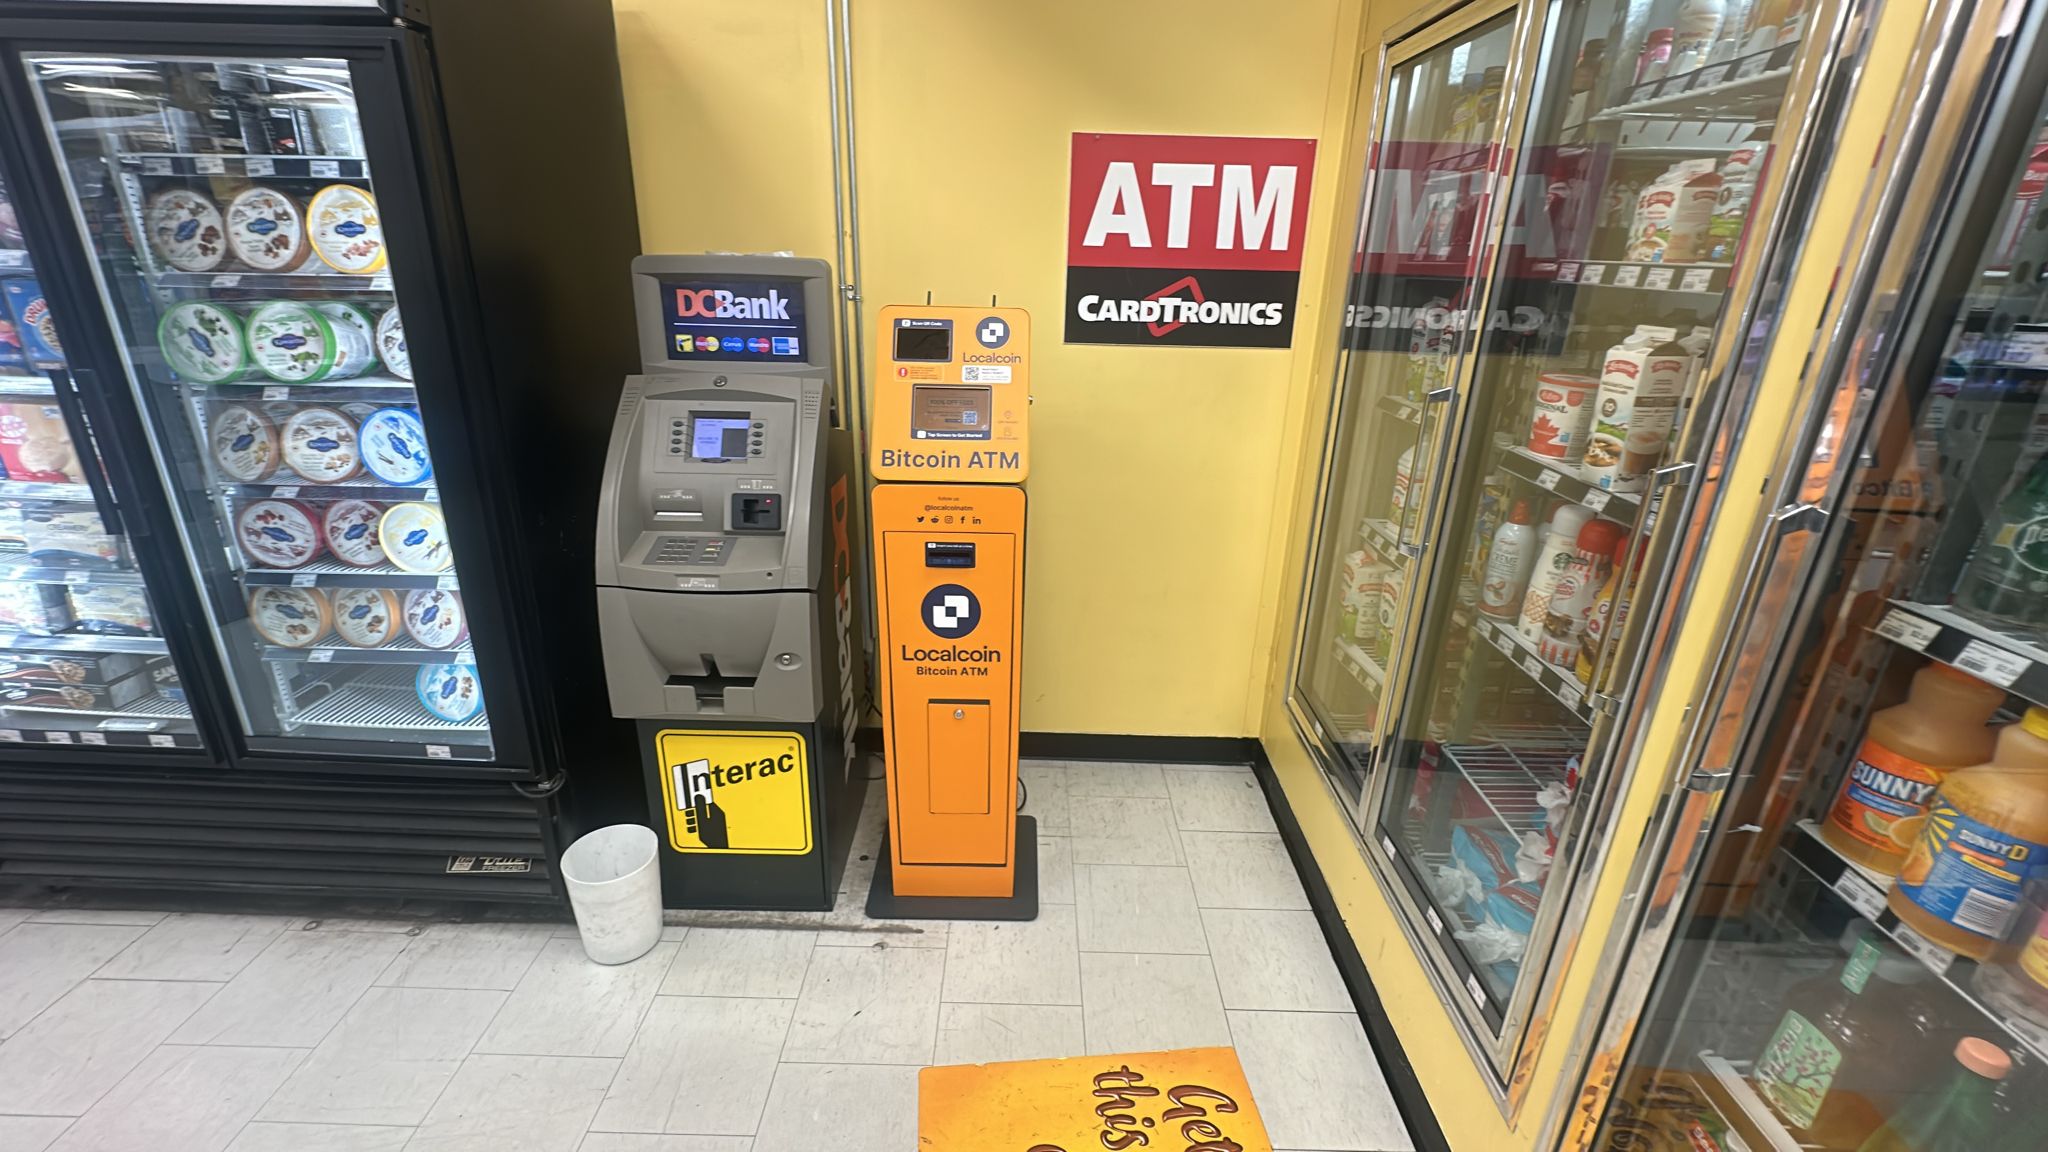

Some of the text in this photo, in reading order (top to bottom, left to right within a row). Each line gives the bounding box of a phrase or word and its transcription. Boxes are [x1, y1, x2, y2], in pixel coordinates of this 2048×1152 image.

[1083, 161, 1298, 251] ATM
[675, 288, 791, 320] DCBank
[1077, 294, 1283, 326] CARDTRONICS
[963, 352, 1021, 364] Localcoin
[881, 449, 1019, 469] Bitcoin ATM
[901, 645, 1001, 663] Localcoin
[916, 666, 988, 676] Bitcoin ATM
[680, 753, 795, 808] Interac
[1851, 760, 1936, 805] SUNNY
[1092, 1064, 1160, 1150] this
[1162, 1084, 1245, 1152] Get
